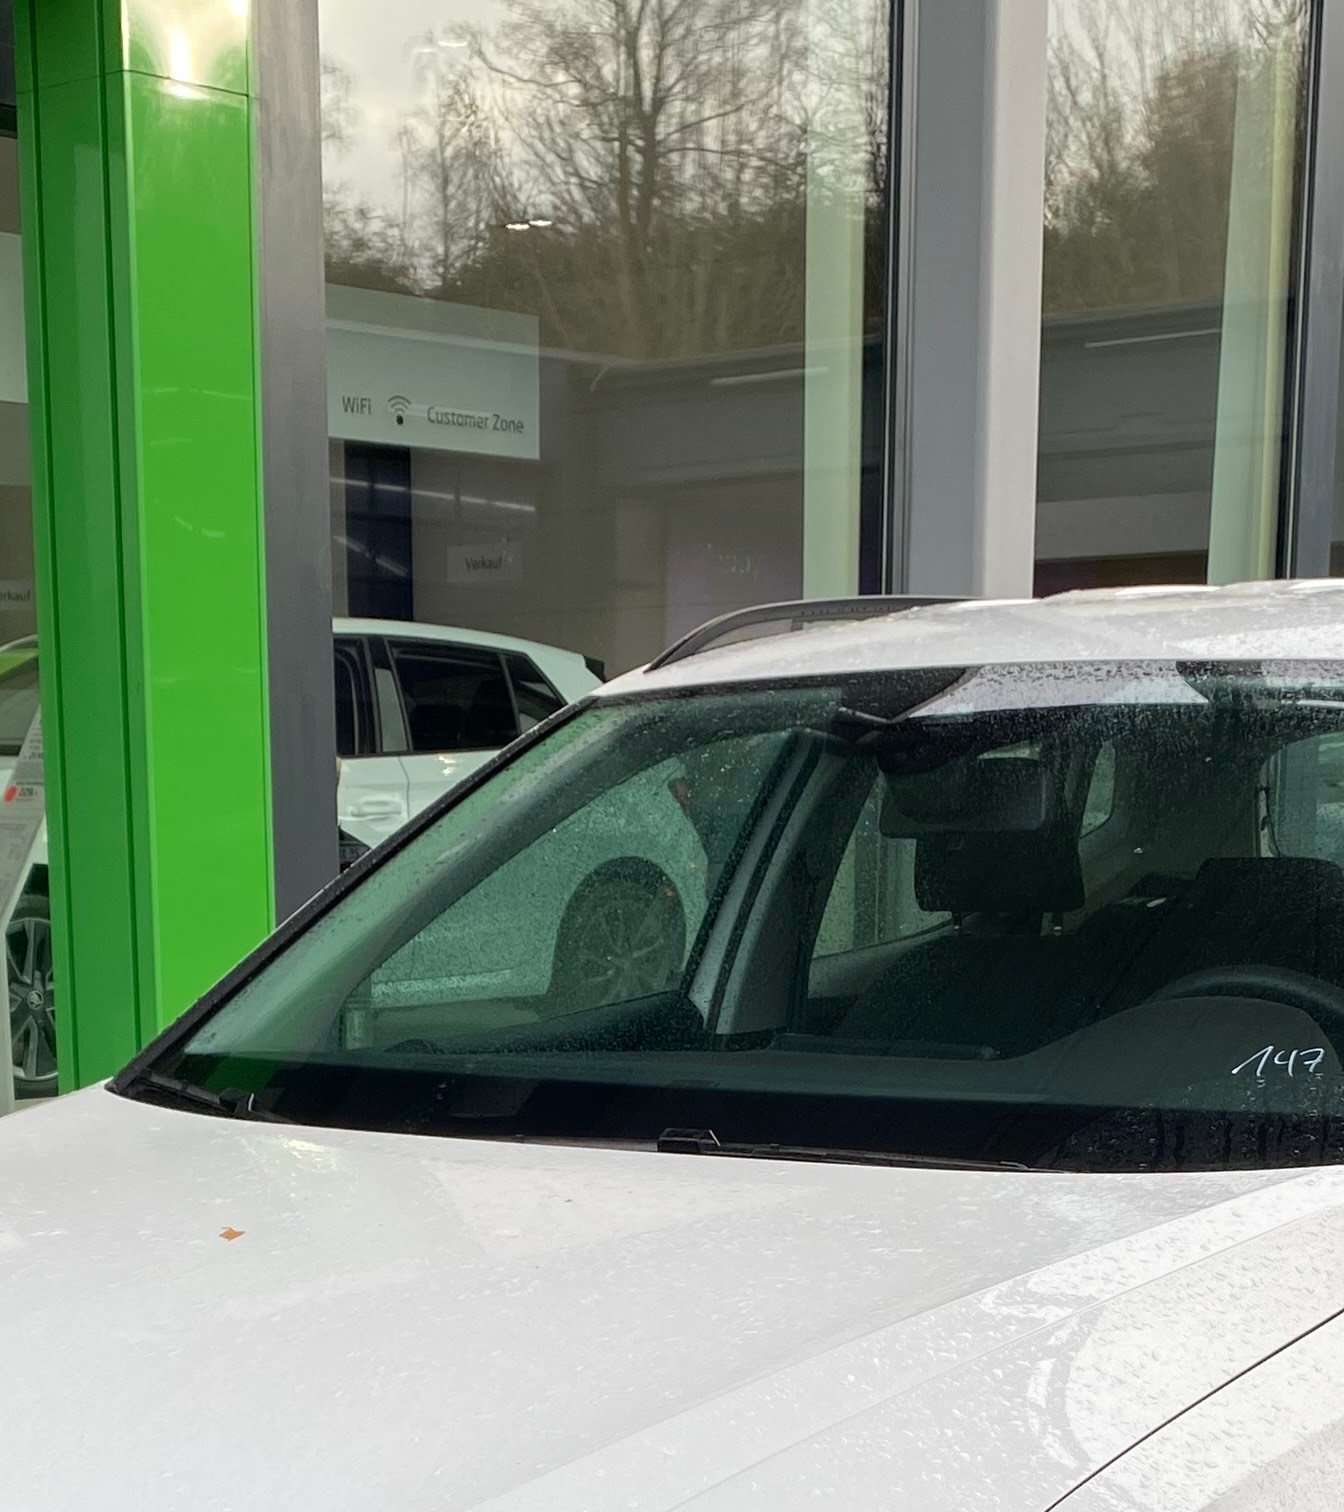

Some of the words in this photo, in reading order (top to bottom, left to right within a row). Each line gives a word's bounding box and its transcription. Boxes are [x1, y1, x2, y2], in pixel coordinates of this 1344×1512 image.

[341, 395, 373, 416] WiFi
[426, 405, 489, 430] Customer
[492, 413, 526, 434] Zone
[1231, 1045, 1325, 1078] 147
